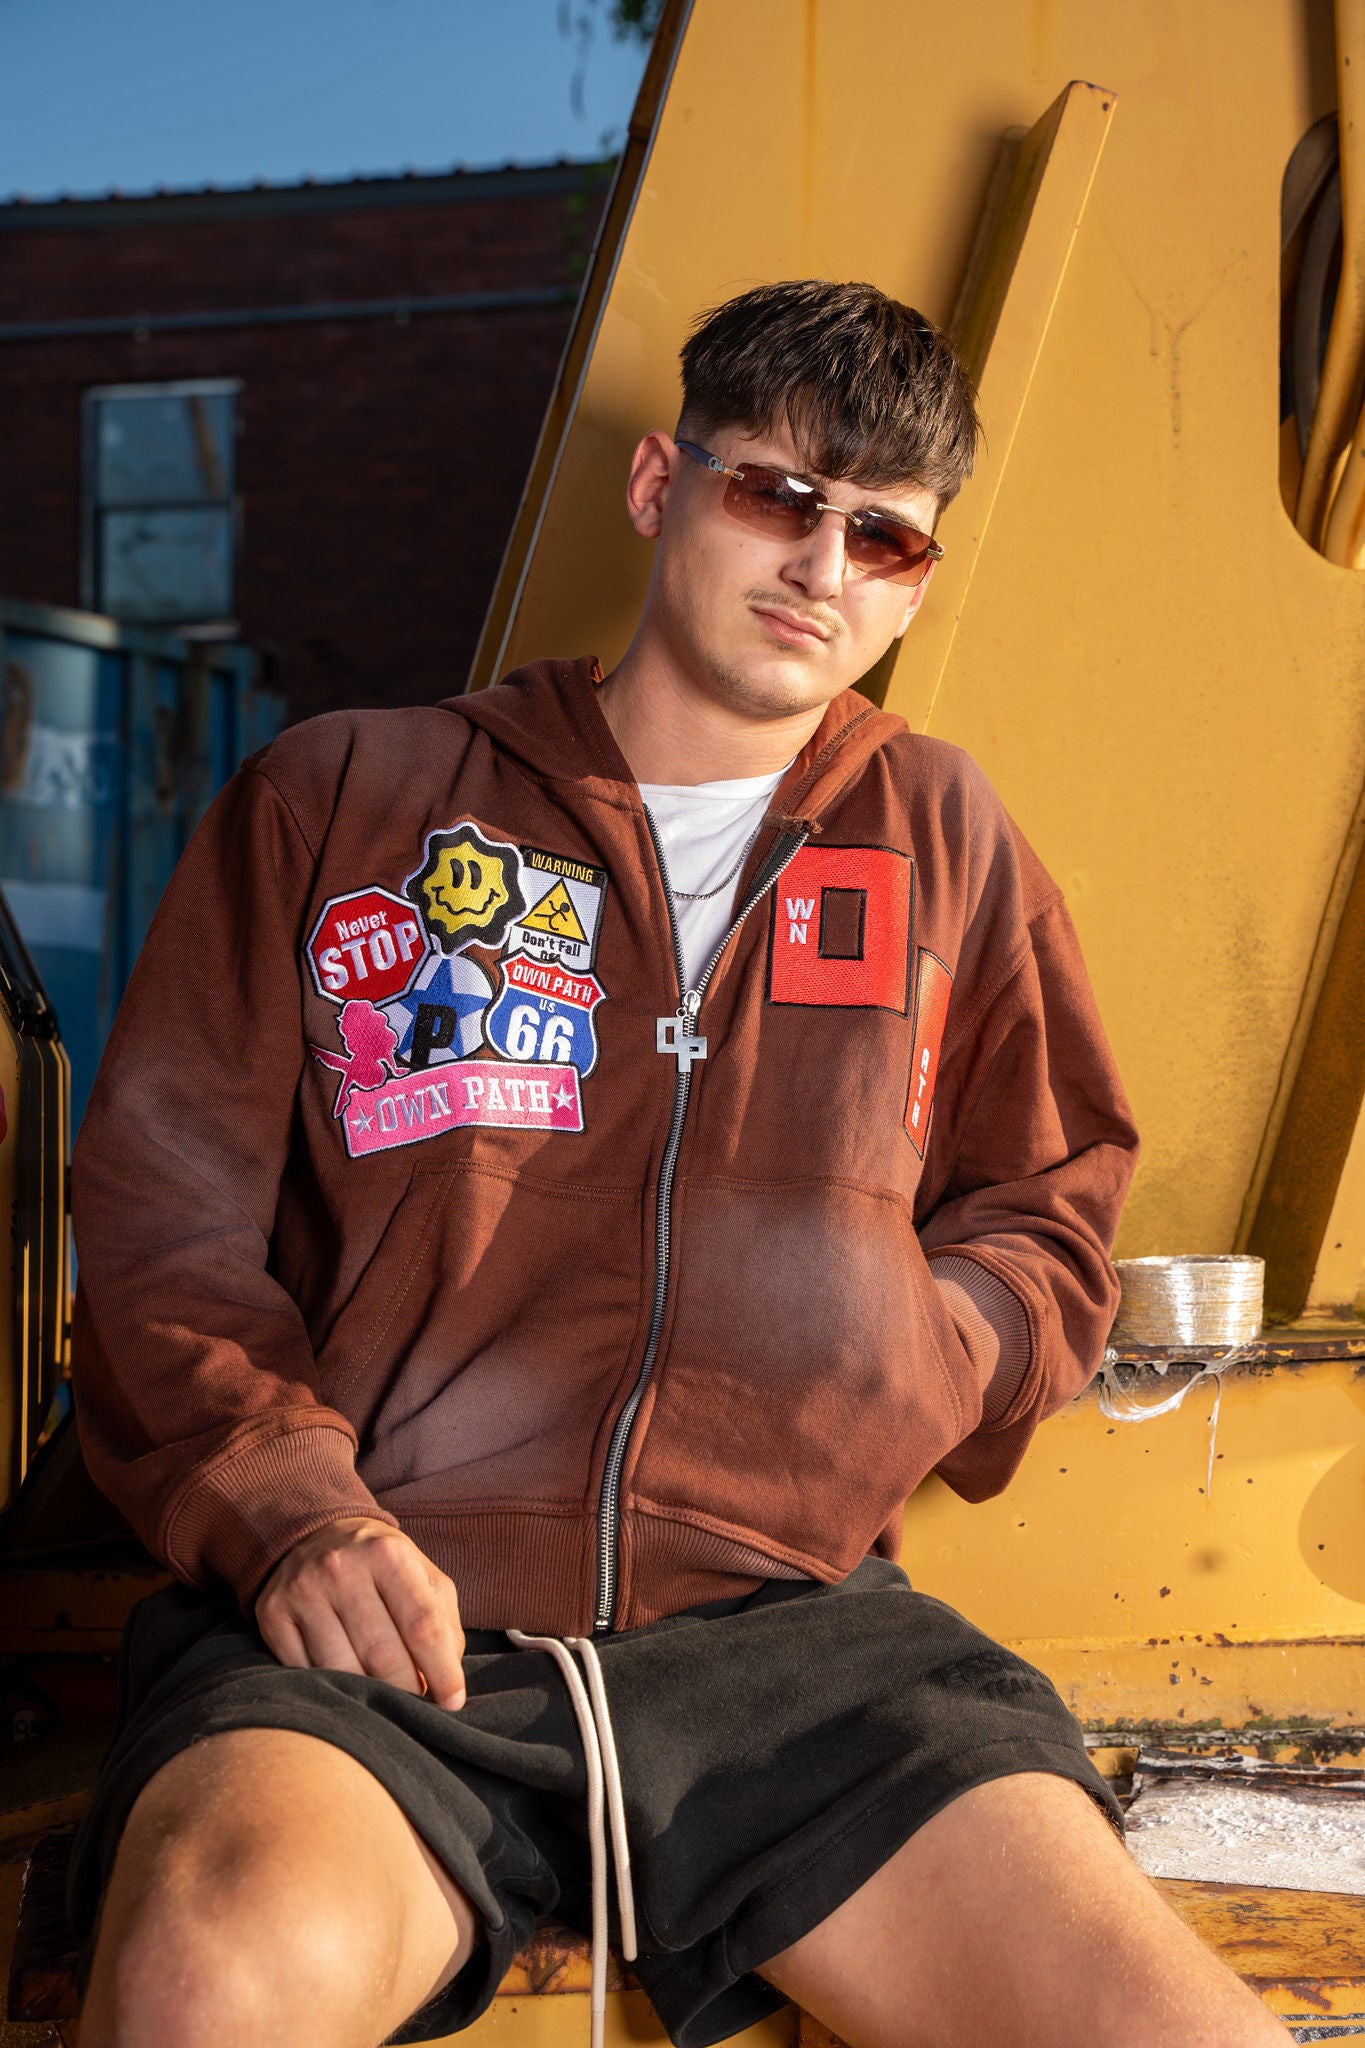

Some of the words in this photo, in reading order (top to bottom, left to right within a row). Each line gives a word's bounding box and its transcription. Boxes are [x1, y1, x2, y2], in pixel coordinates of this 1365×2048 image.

[531, 852, 594, 883] WARNING
[335, 911, 388, 941] Never
[522, 930, 555, 949] Don't
[559, 939, 582, 957] Fall
[319, 920, 419, 990] STOP
[512, 964, 551, 990] OWN
[552, 977, 593, 1003] PATH
[539, 998, 556, 1013] US
[410, 1003, 457, 1066] P
[505, 1004, 575, 1062] 66
[375, 1081, 452, 1132] OWN
[461, 1076, 553, 1113] PATH
